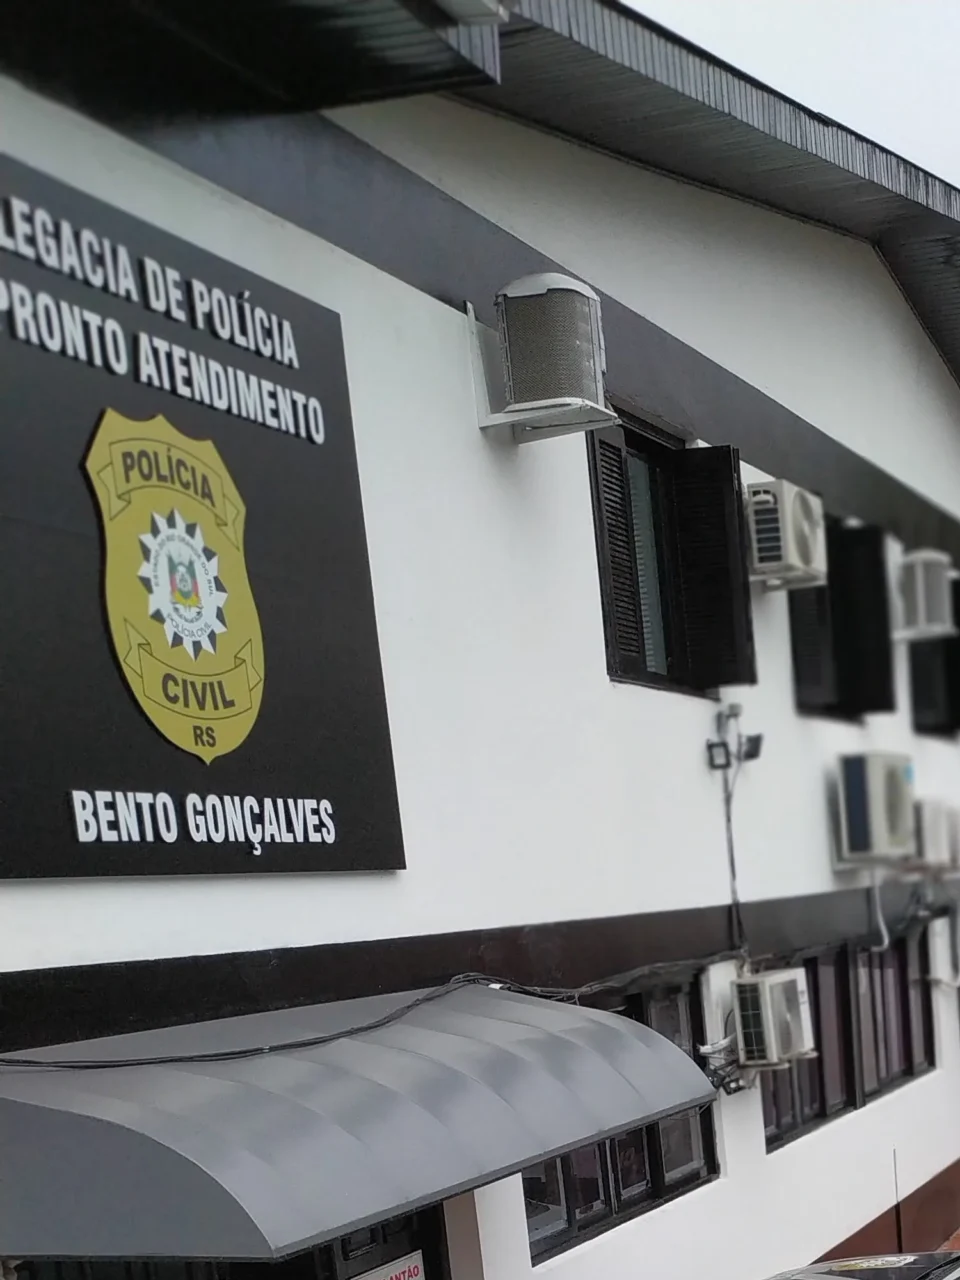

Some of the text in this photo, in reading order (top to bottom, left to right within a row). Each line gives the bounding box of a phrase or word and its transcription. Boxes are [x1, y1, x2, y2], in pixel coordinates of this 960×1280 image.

[143, 256, 187, 322] DE
[192, 278, 300, 369] POLÍCIA
[138, 332, 326, 445] ATENDIMENTO
[121, 448, 216, 507] POLÍCIA
[161, 672, 236, 712] CIVIL
[192, 725, 217, 749] RS
[71, 788, 336, 856] BENTO GONÇALVES
